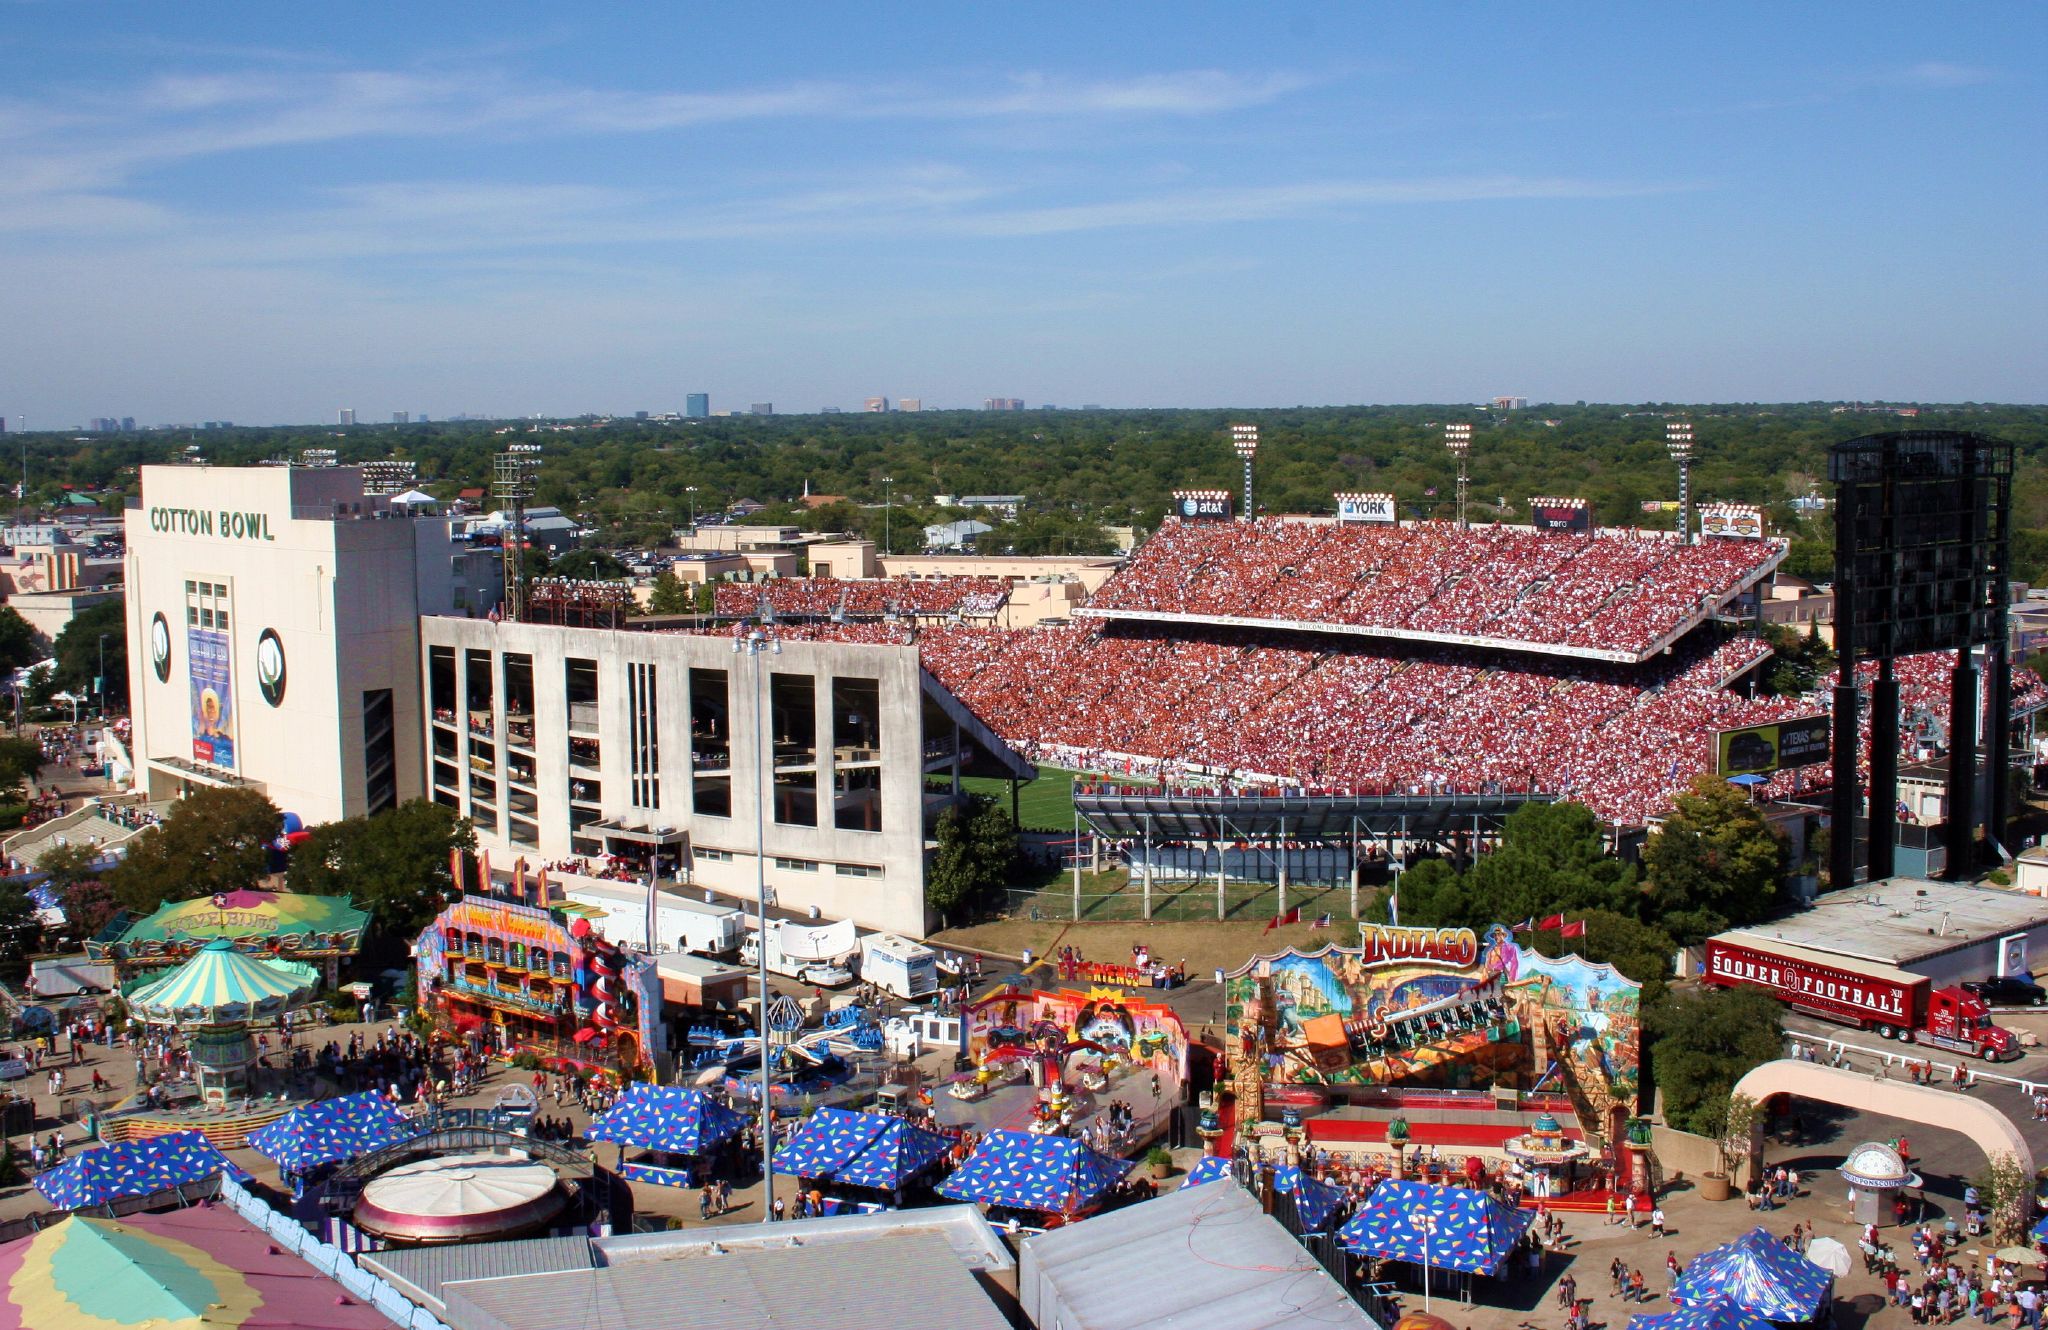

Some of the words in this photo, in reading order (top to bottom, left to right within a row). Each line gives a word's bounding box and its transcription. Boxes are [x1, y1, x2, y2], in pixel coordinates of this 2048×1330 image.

[1199, 501, 1223, 514] at&t
[1354, 501, 1387, 514] YORK
[151, 506, 213, 536] COTTON
[220, 511, 275, 541] BOWL
[1549, 520, 1568, 528] zero
[1298, 622, 1325, 631] WELCOME
[1789, 730, 1810, 745] TEXAS
[1360, 923, 1476, 966] INDIAGO
[911, 956, 933, 970] EMP
[1713, 955, 1780, 985] SOONER
[1803, 976, 1903, 1014] FOOTBALL
